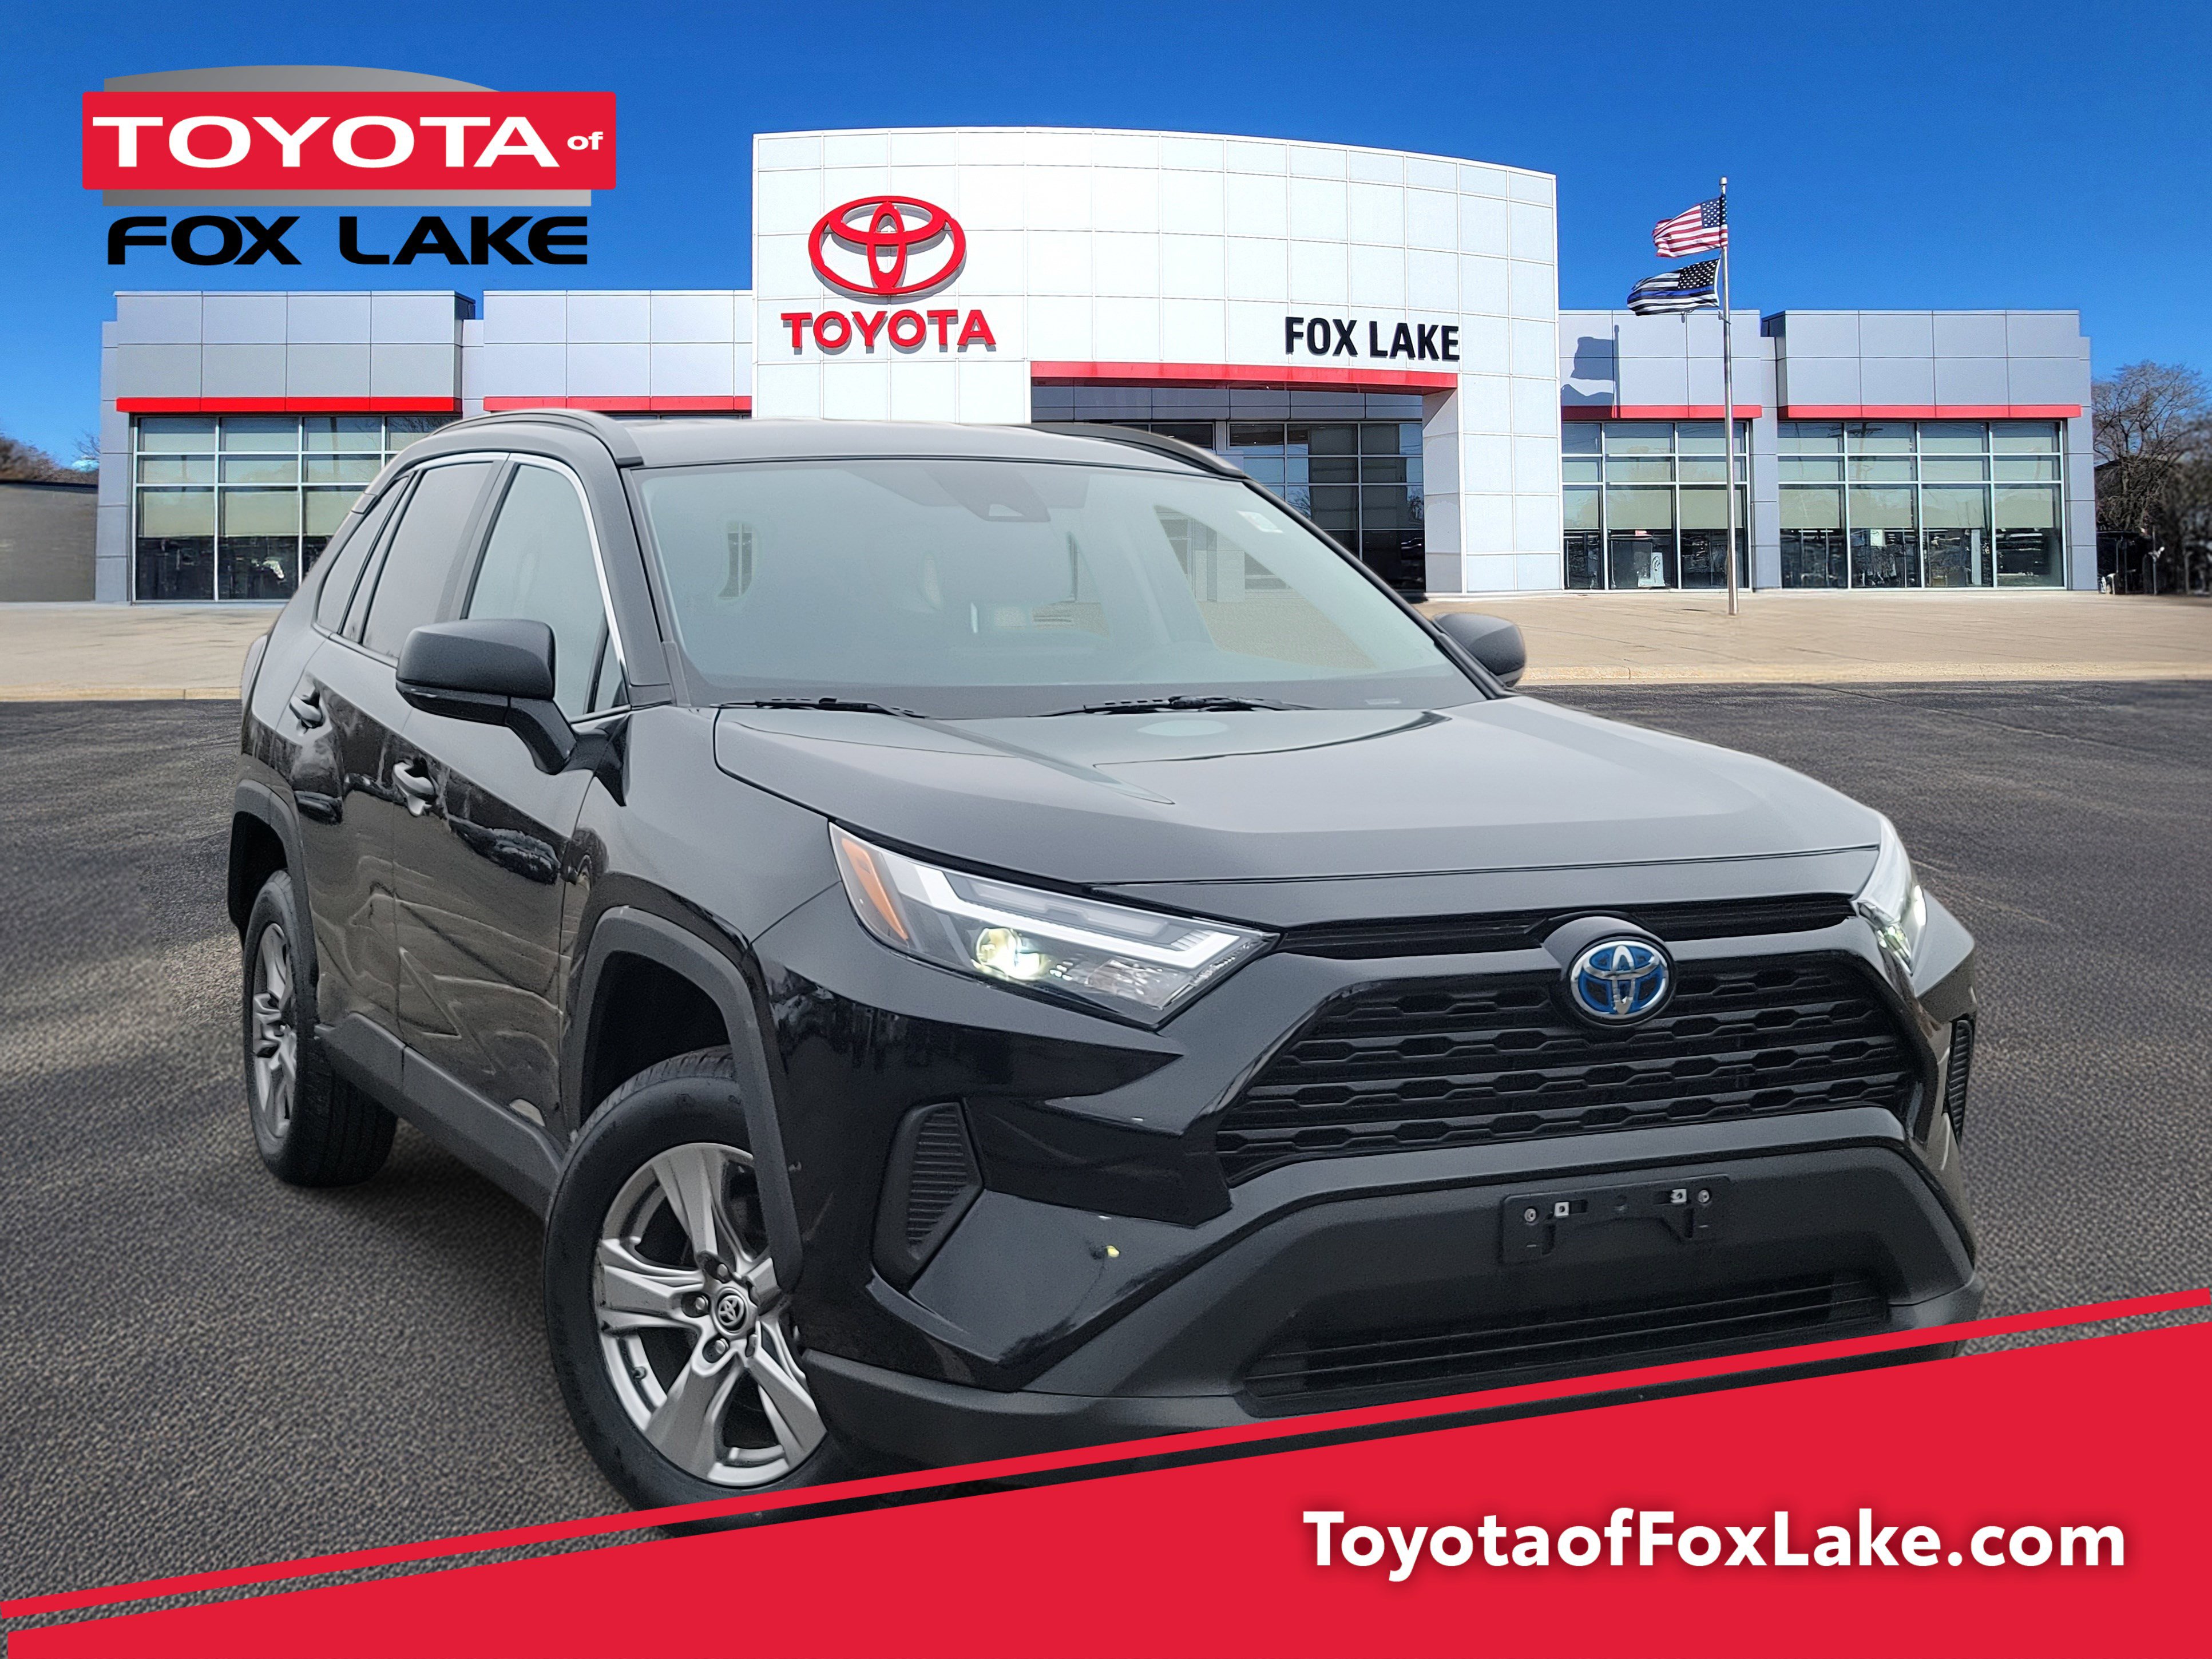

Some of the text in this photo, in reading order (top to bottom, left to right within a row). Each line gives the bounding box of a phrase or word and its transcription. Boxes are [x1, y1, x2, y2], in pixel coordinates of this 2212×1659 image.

[780, 310, 996, 349] TOYOTA
[1285, 316, 1460, 361] FOX LAKE
